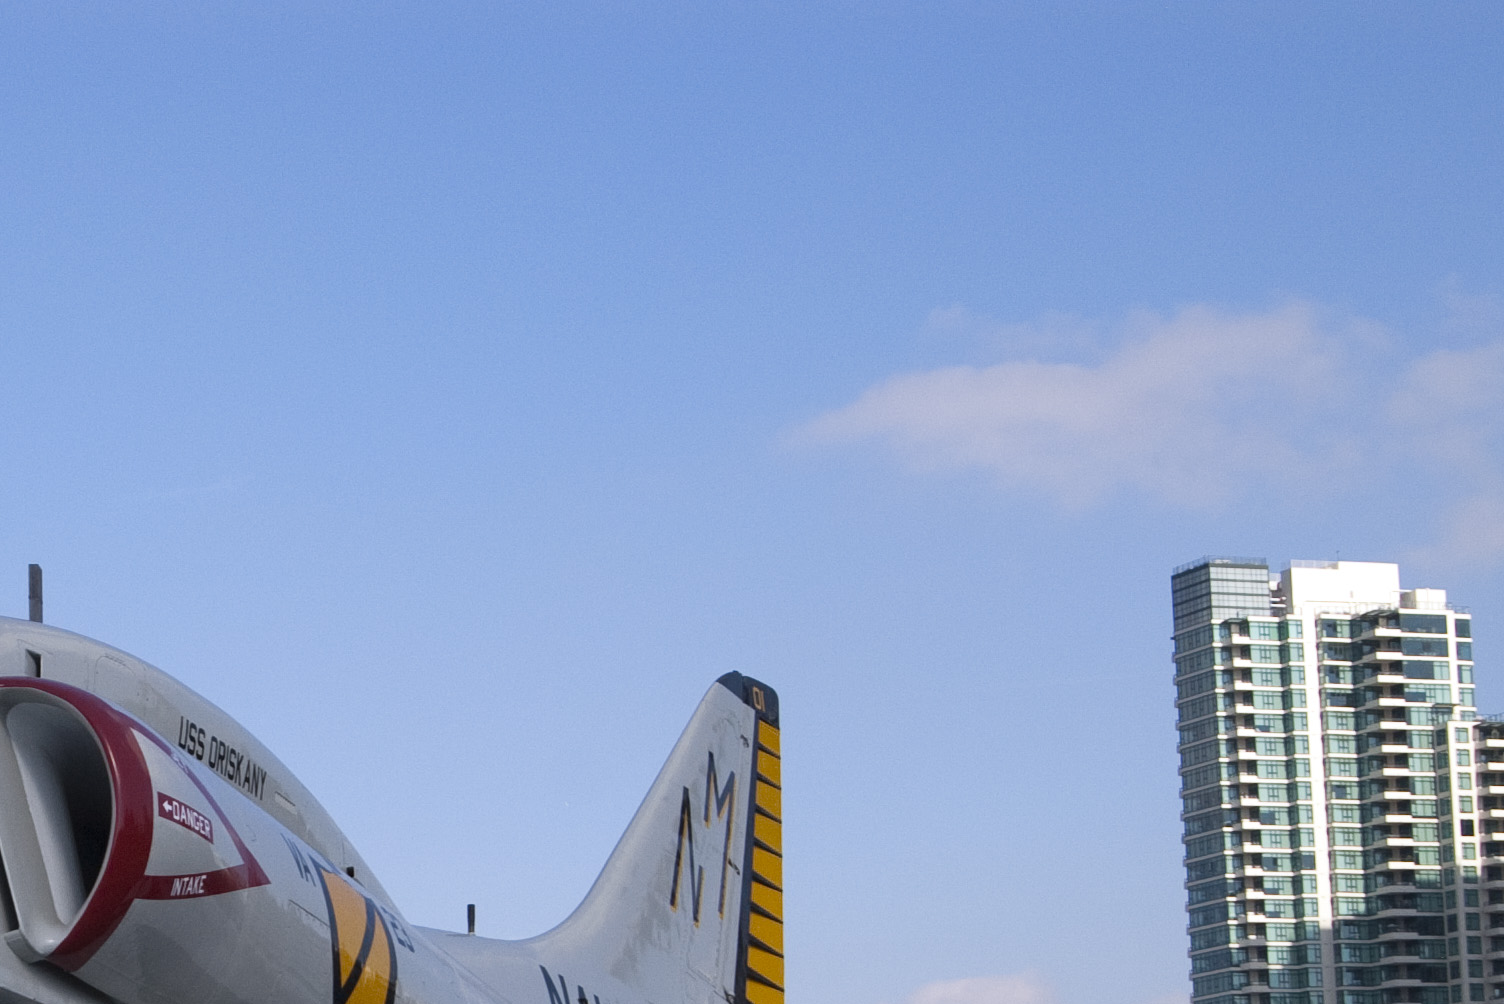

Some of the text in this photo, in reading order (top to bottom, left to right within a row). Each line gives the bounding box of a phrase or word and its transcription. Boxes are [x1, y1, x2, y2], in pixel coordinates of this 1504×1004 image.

[752, 686, 766, 712] 01
[178, 716, 267, 800] USS ORISKANY
[172, 801, 211, 838] DANGER
[170, 874, 207, 896] INTAKE
